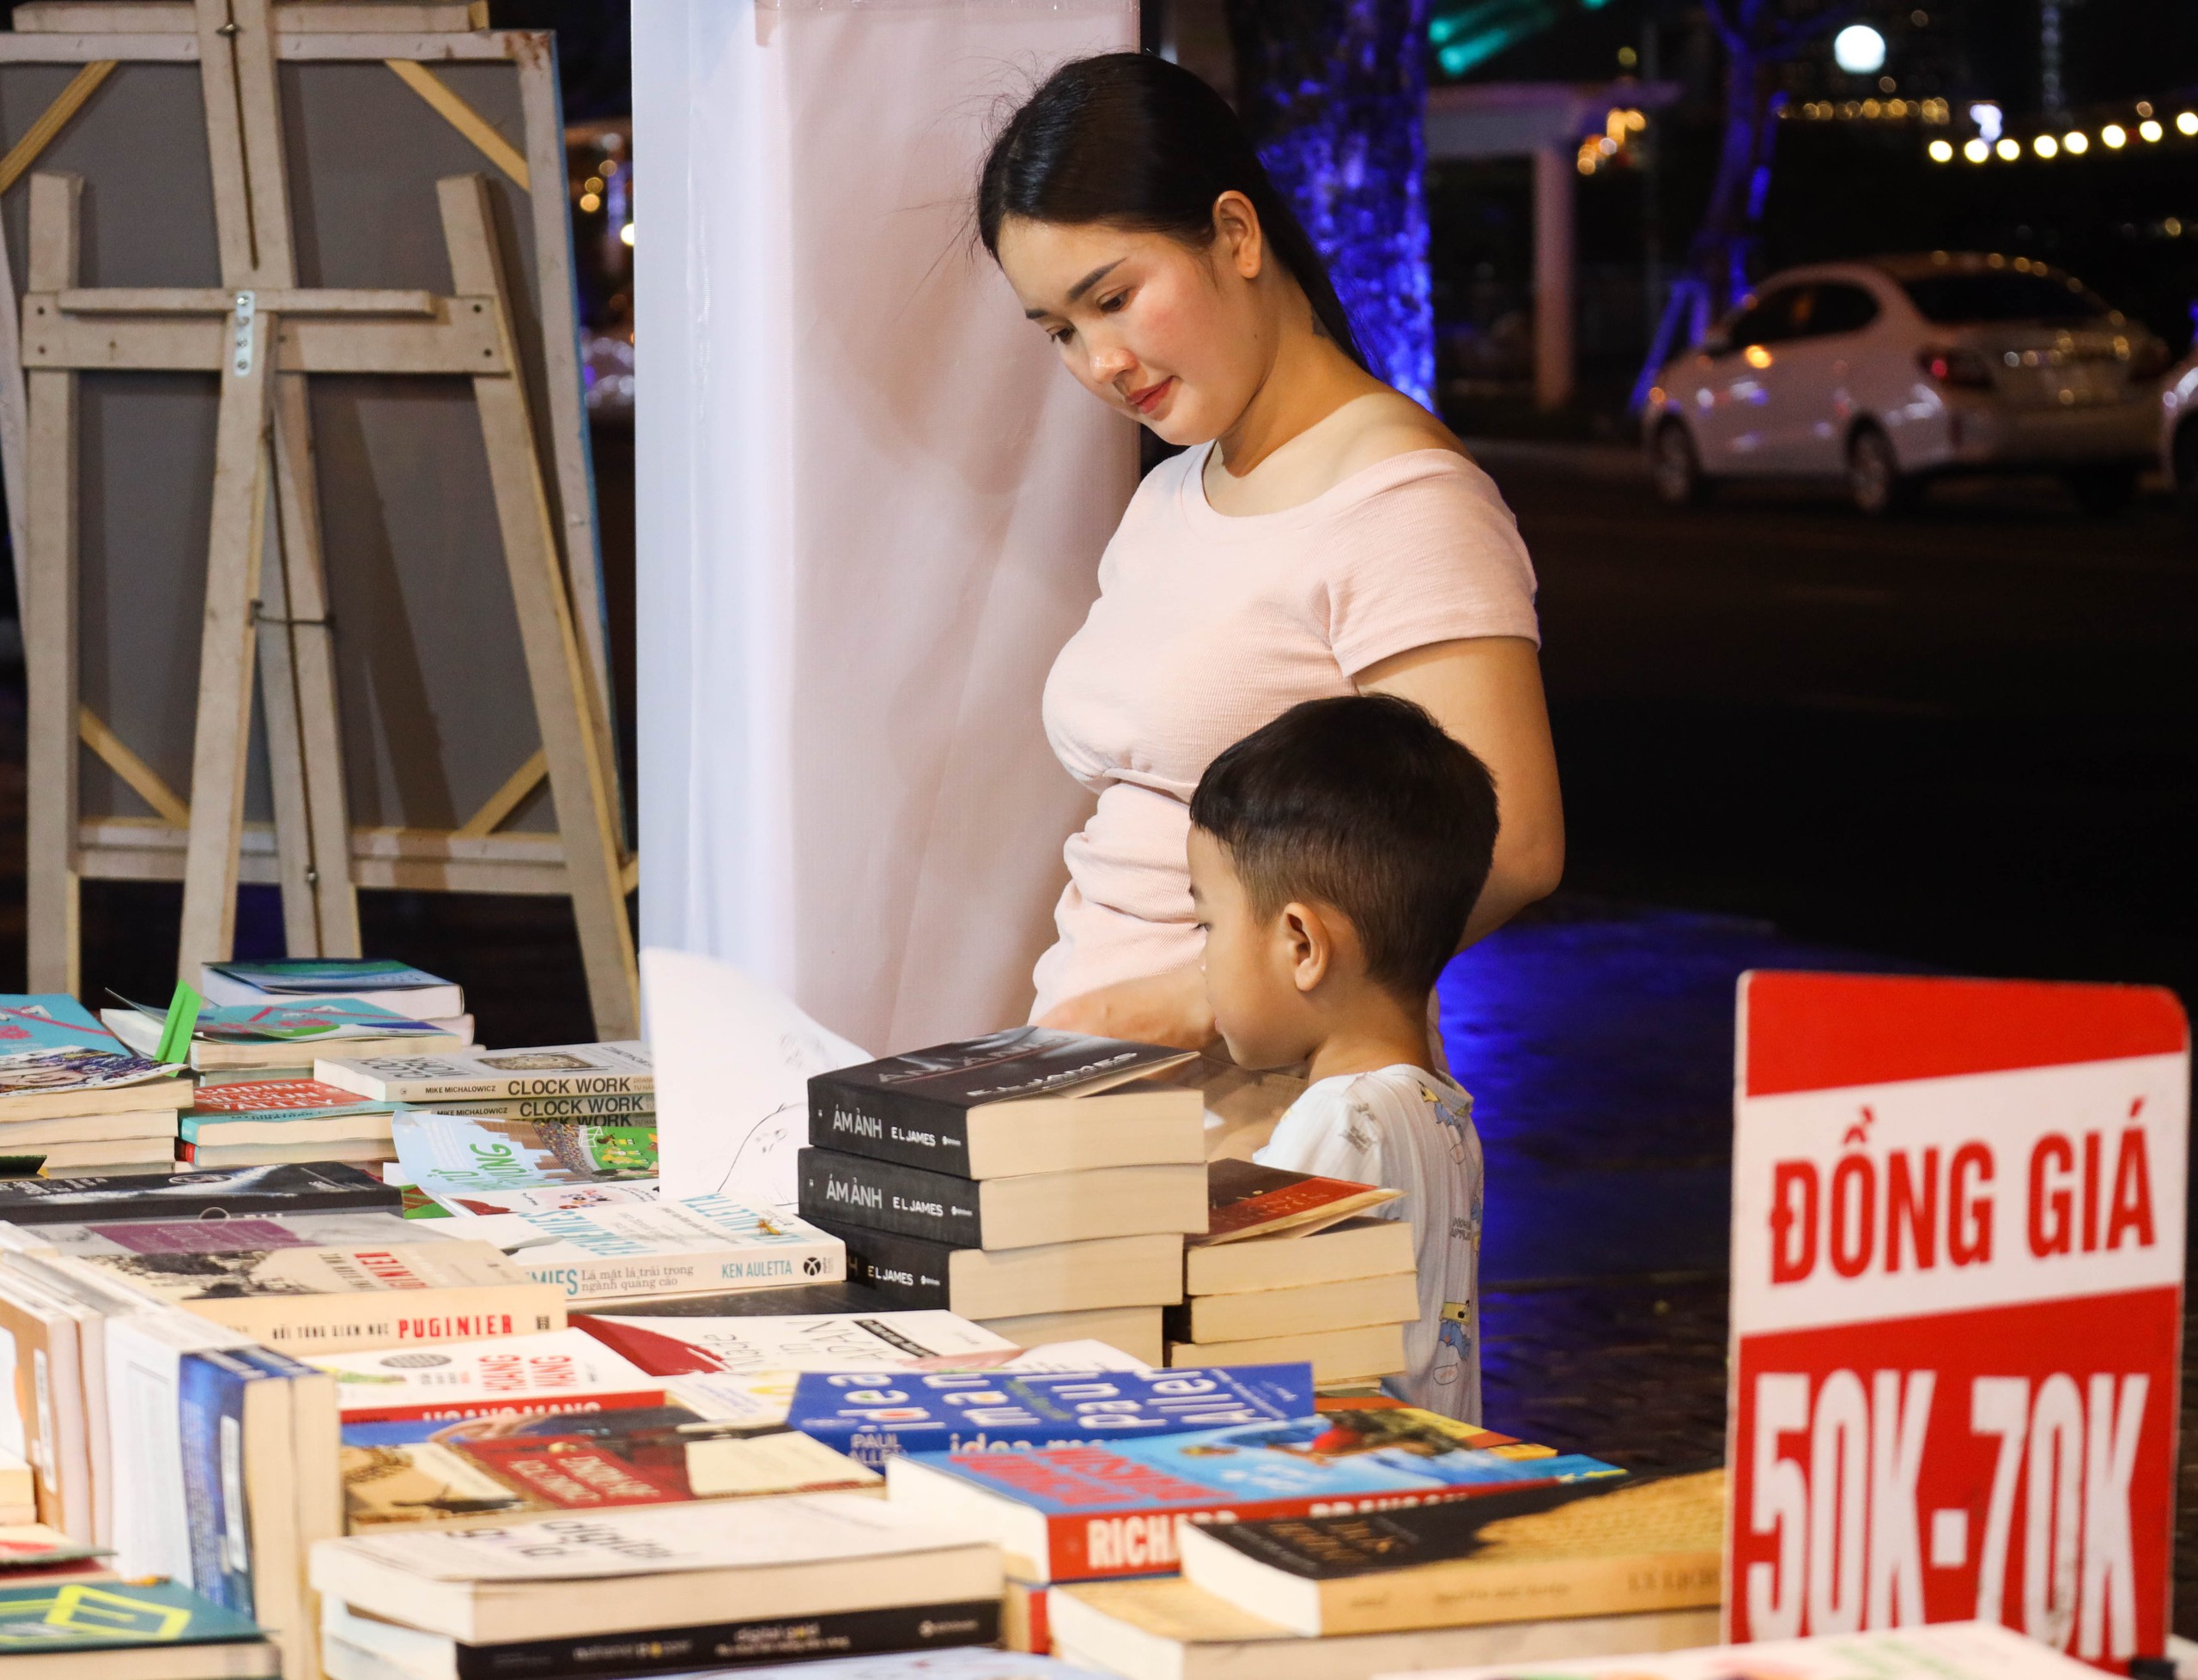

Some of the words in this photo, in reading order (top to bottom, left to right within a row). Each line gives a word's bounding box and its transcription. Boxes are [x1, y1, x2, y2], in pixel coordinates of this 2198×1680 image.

[445, 1085, 496, 1094] MICHALOWICZ
[507, 1079, 569, 1095] CLOCK
[575, 1077, 631, 1094] WORK
[519, 1099, 582, 1117] CLOCK
[588, 1095, 644, 1113] WORK
[833, 1104, 853, 1133] ÁM
[854, 1107, 883, 1138] ẢNH
[891, 1126, 898, 1139] E
[899, 1128, 906, 1141] L
[906, 1130, 936, 1147] JAMES
[826, 1174, 849, 1202] ÁM
[851, 1178, 883, 1209] ẢNH
[893, 1197, 900, 1208] E
[902, 1198, 908, 1210] L
[909, 1199, 944, 1217] JAMES
[1767, 1105, 1996, 1285] ĐỒNG
[2025, 1095, 2157, 1260] GIÁ
[664, 1265, 694, 1277] trong
[722, 1263, 744, 1279] KEN
[746, 1259, 792, 1277] AULETTA
[867, 1265, 874, 1277] E
[875, 1266, 882, 1279] L
[883, 1268, 914, 1286] JAMES
[398, 1313, 513, 1339] PUGINIER
[828, 1374, 945, 1432] idea
[922, 1373, 1041, 1428] man
[850, 1433, 902, 1448] PAUL
